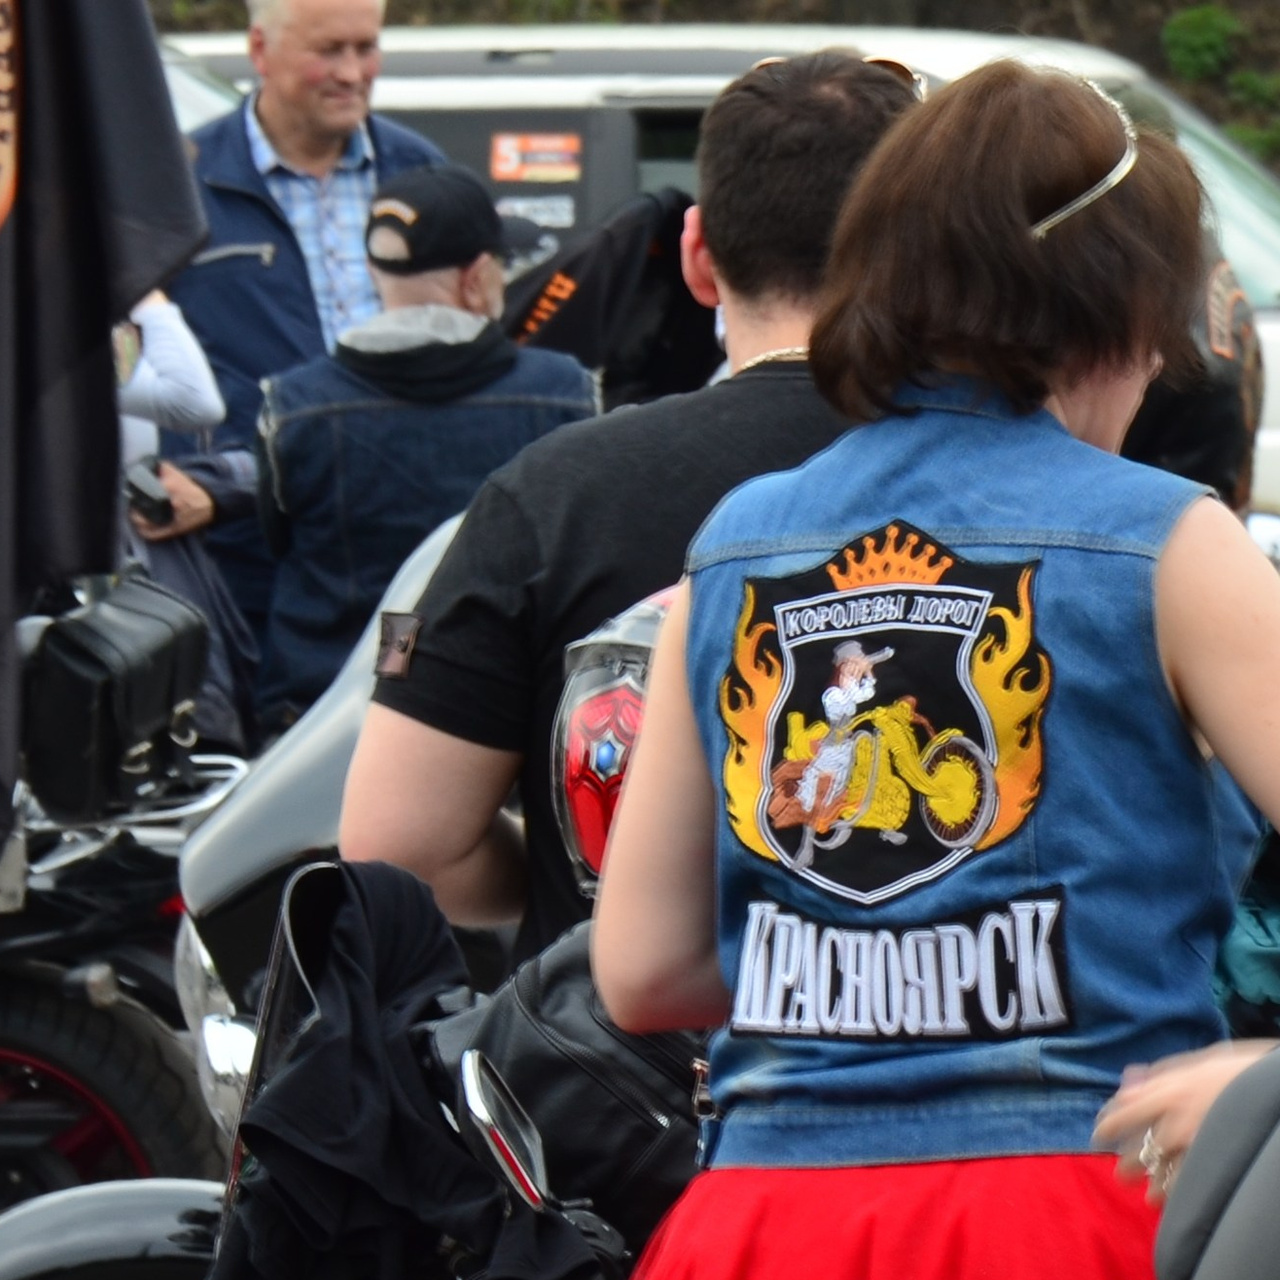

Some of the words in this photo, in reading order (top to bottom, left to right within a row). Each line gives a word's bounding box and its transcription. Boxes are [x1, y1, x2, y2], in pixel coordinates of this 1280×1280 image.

[785, 594, 905, 637] КОРОЛЕВЫ
[909, 595, 980, 626] ДОРОГ
[732, 900, 1067, 1035] КРАСНОЯРСК
